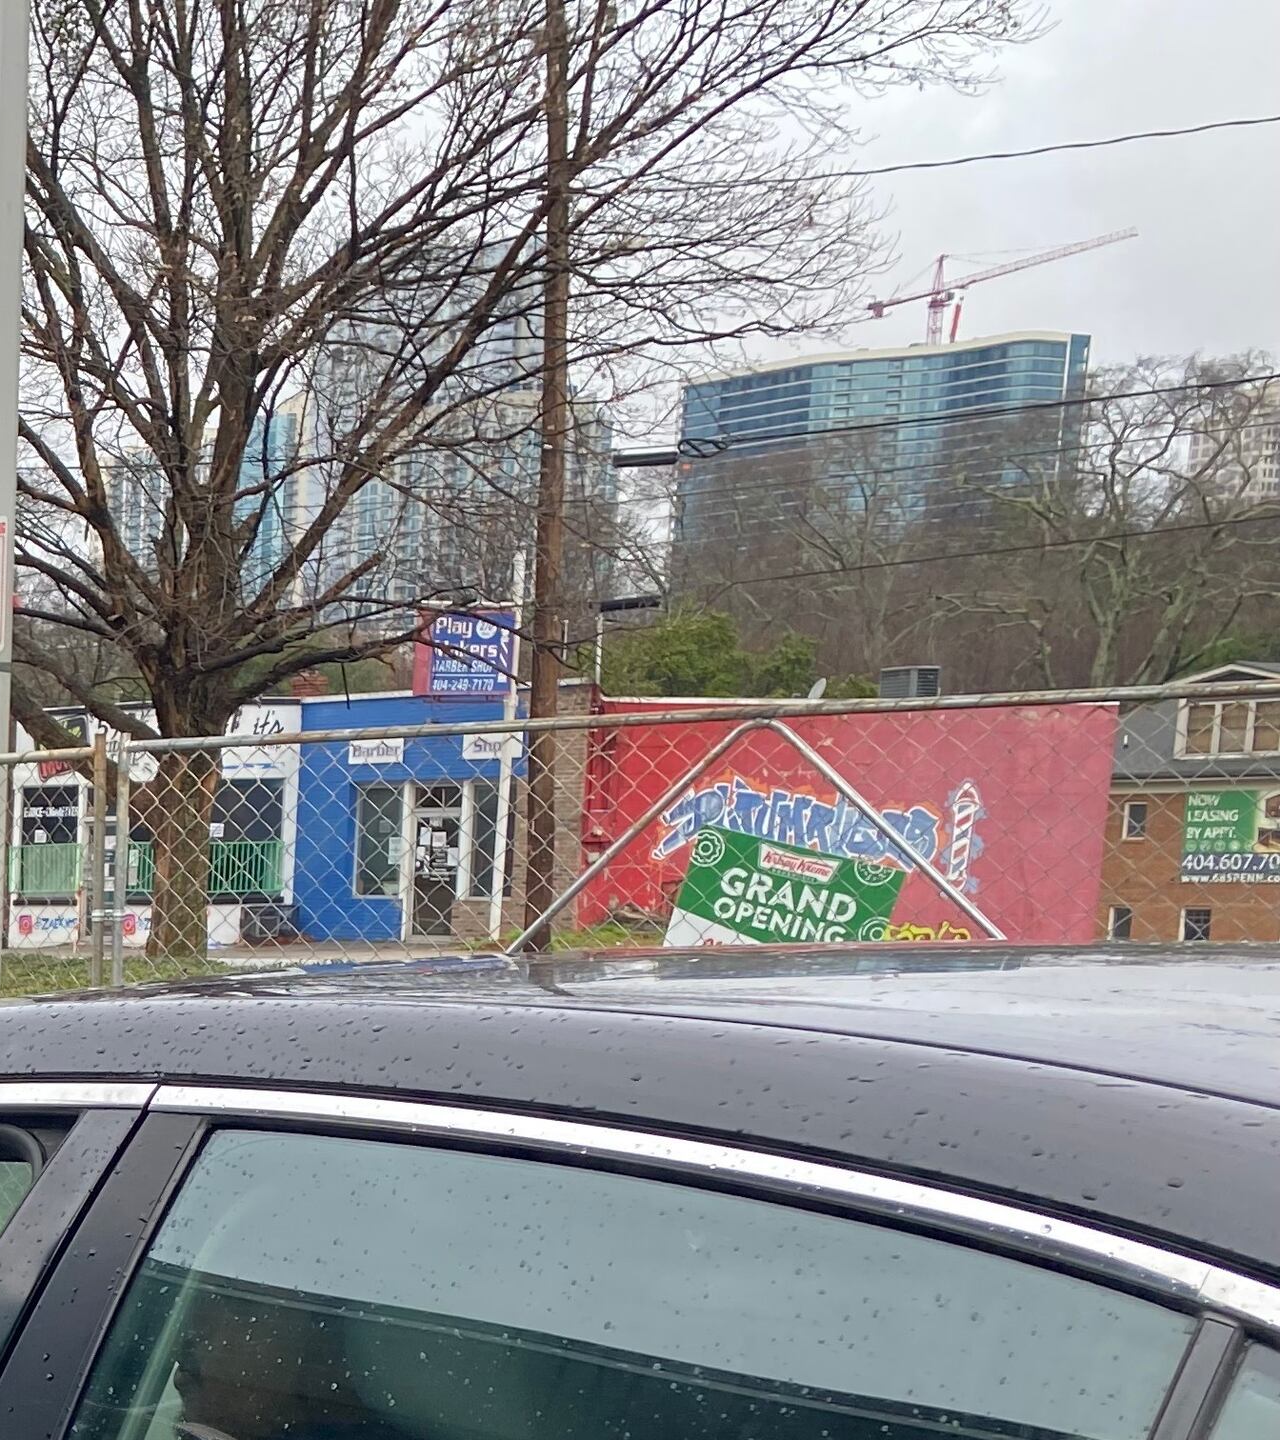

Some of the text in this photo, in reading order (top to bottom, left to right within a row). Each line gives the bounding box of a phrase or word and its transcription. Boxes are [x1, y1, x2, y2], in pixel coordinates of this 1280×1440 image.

[436, 617, 473, 638] Play
[352, 744, 400, 758] Barber
[473, 739, 502, 753] Sho
[1188, 794, 1220, 807] NOW
[1187, 809, 1239, 822] LEASING
[1186, 827, 1202, 839] BY
[720, 867, 857, 923] GRAND
[713, 896, 847, 942] OPENING
